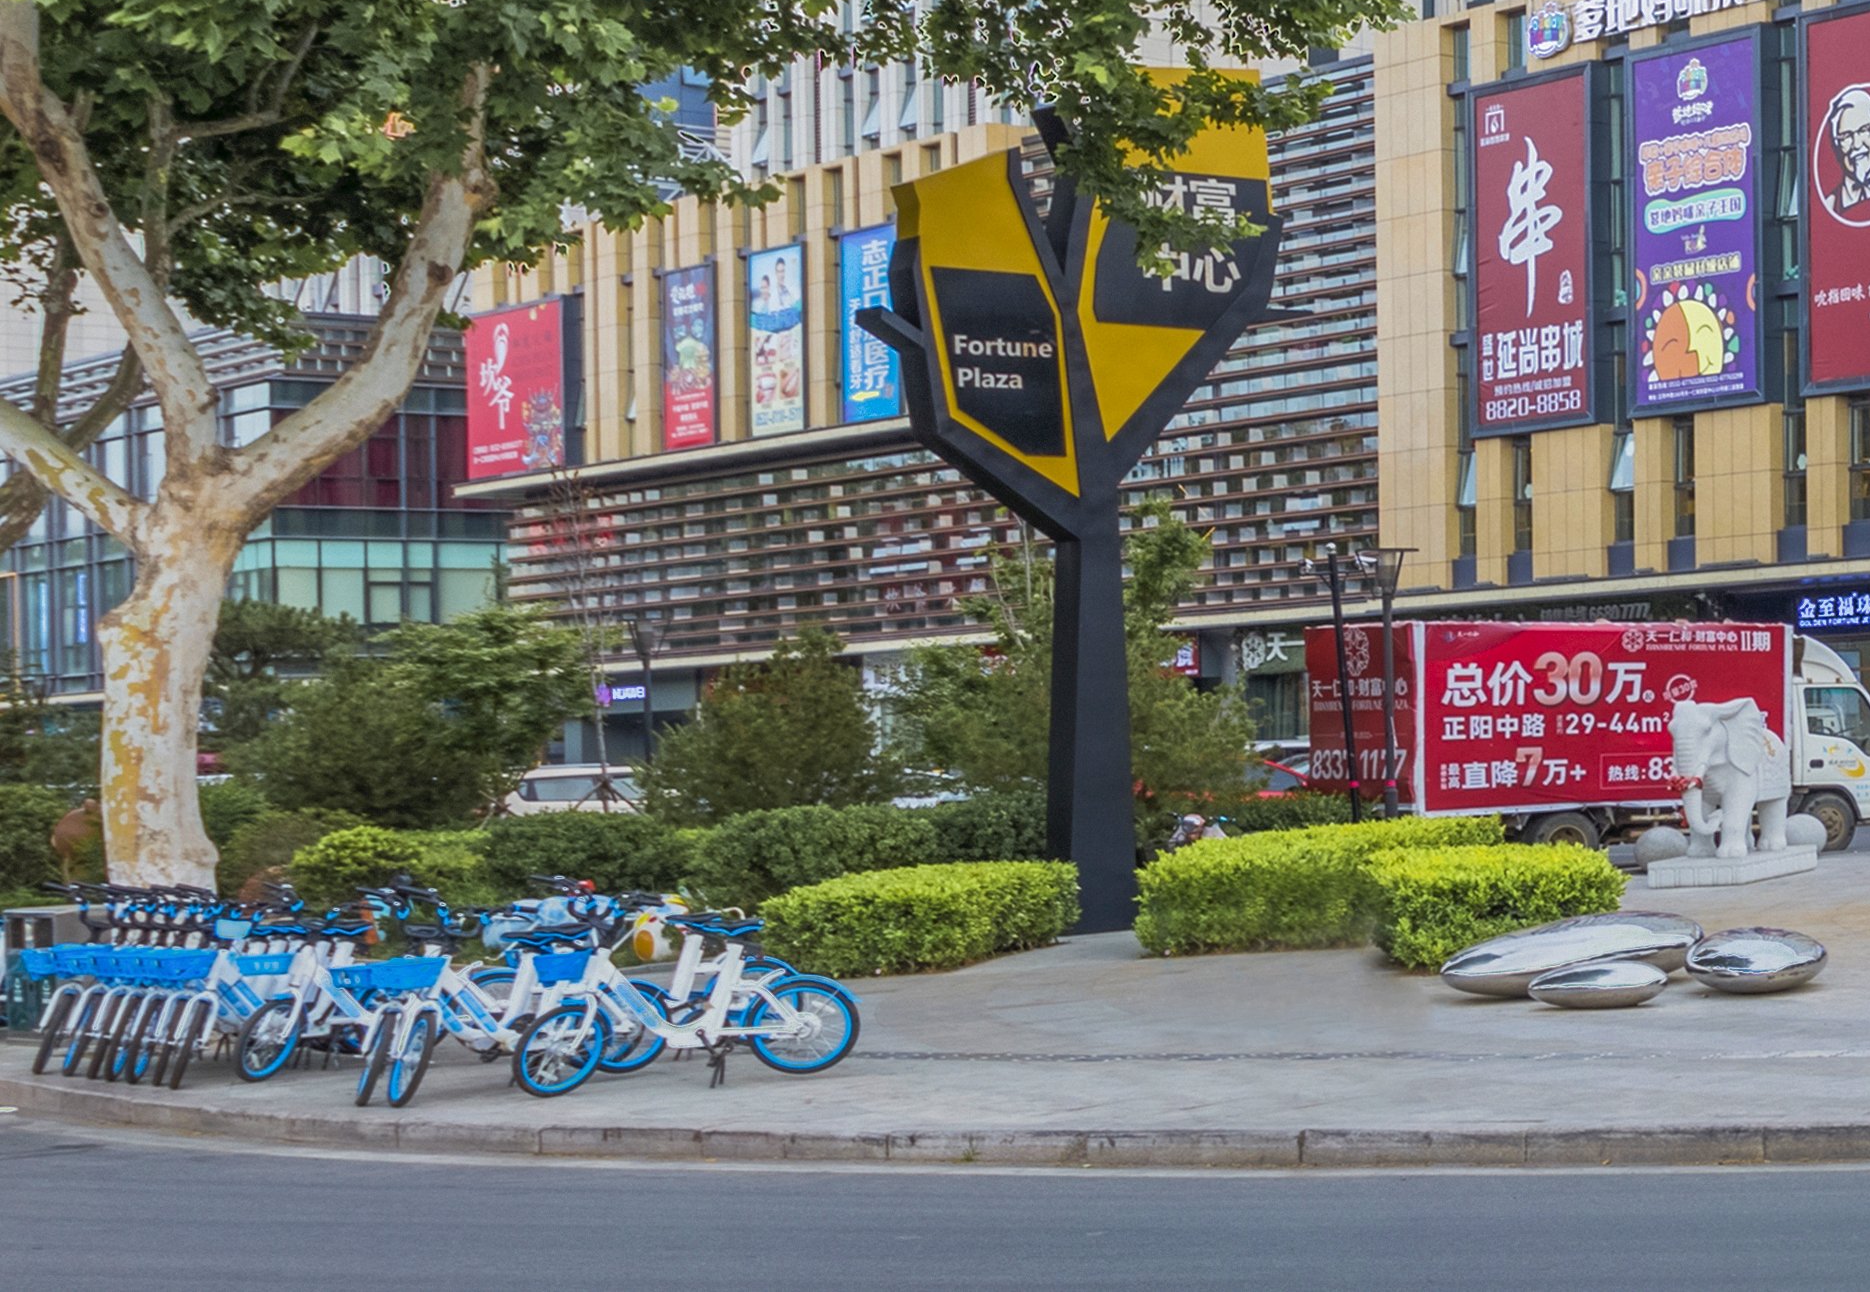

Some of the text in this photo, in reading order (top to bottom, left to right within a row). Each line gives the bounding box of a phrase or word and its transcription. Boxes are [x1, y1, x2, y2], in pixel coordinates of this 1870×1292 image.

[1498, 136, 1563, 318] 串
[862, 239, 890, 390] 志正口医疗
[953, 334, 1053, 359] Fortune
[957, 366, 1024, 390] Plaza
[1486, 389, 1581, 421] 8820-8858
[1441, 713, 1545, 740] 正阳中路
